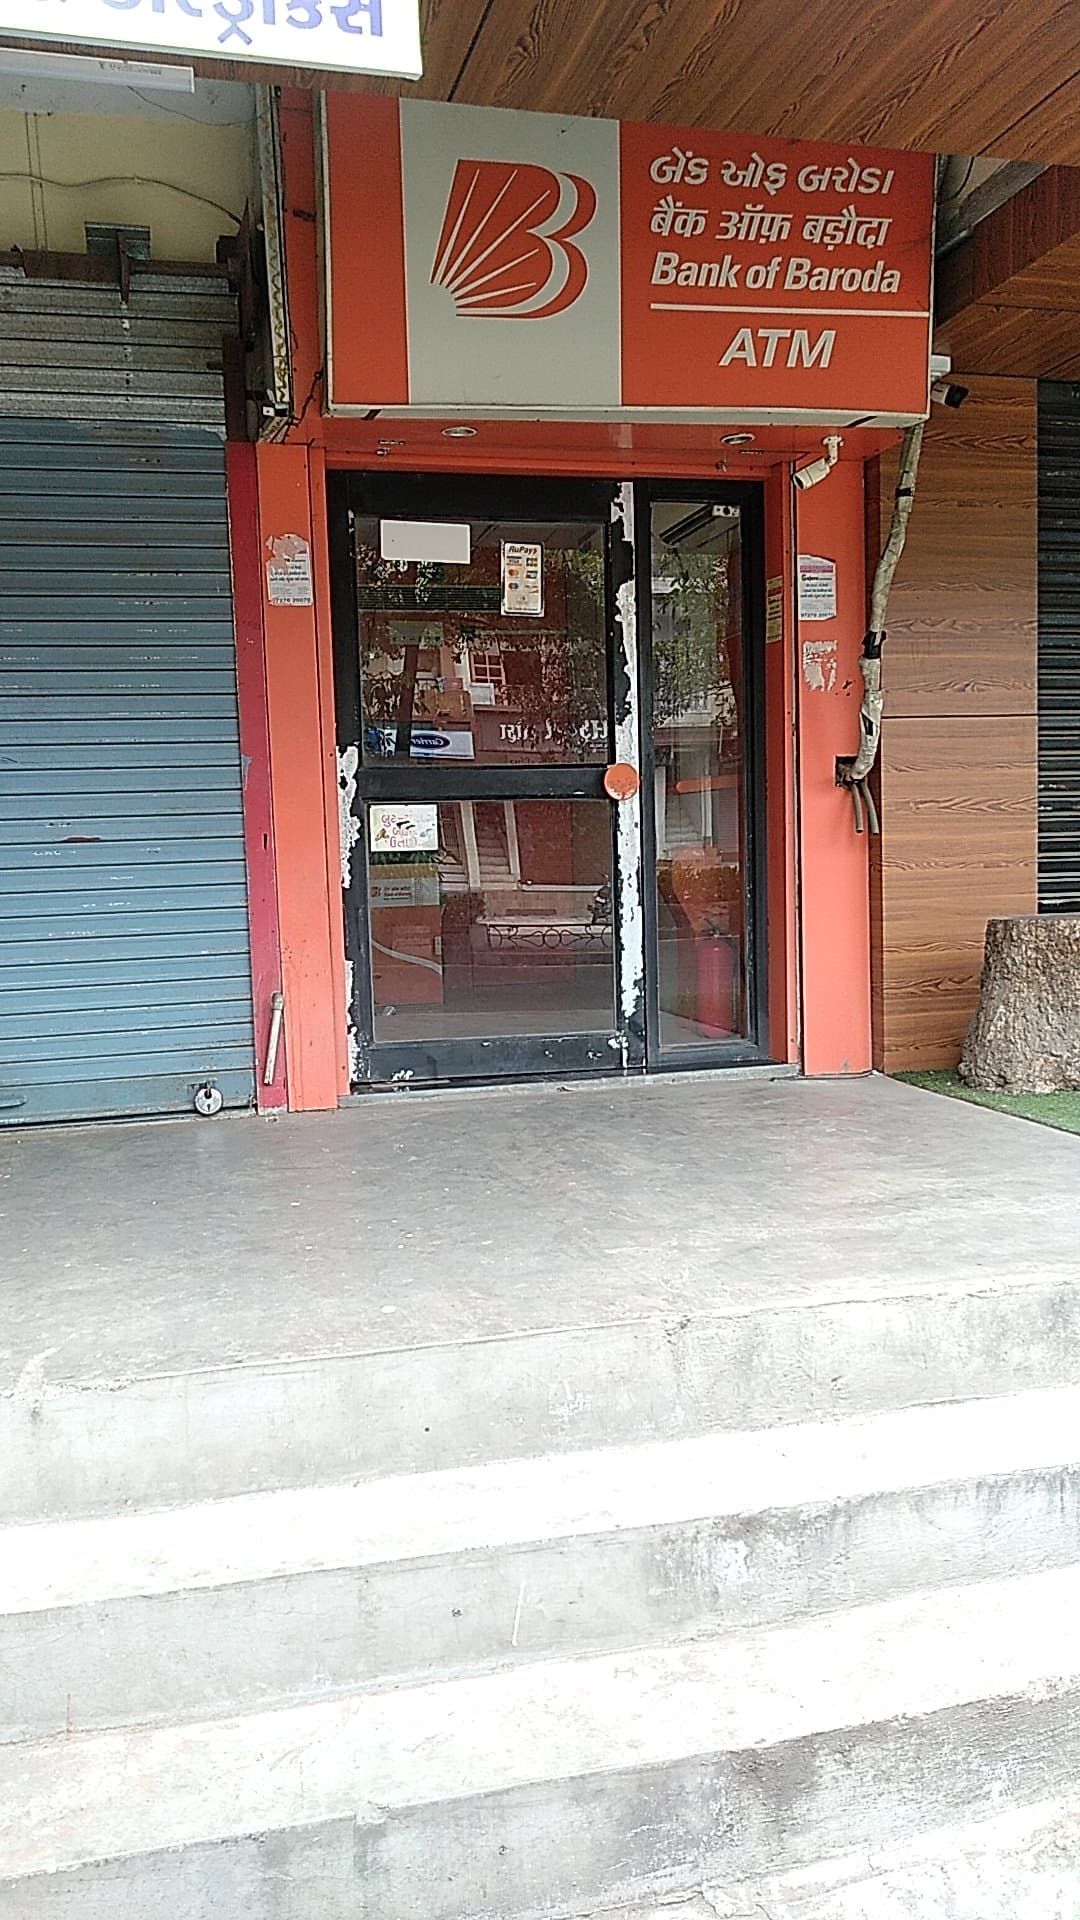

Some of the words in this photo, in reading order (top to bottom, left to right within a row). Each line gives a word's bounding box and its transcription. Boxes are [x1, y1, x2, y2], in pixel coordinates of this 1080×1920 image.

[650, 146, 709, 185] બેંક
[721, 152, 788, 196] ઓફ
[797, 157, 895, 194] બરોડા
[650, 194, 709, 238] बैंक
[802, 204, 893, 251] बड़ौदा
[651, 251, 742, 288] Bank
[745, 256, 782, 290] of
[784, 257, 901, 293] Baroda
[718, 327, 836, 368] ATM
[508, 545, 534, 555] RuPay
